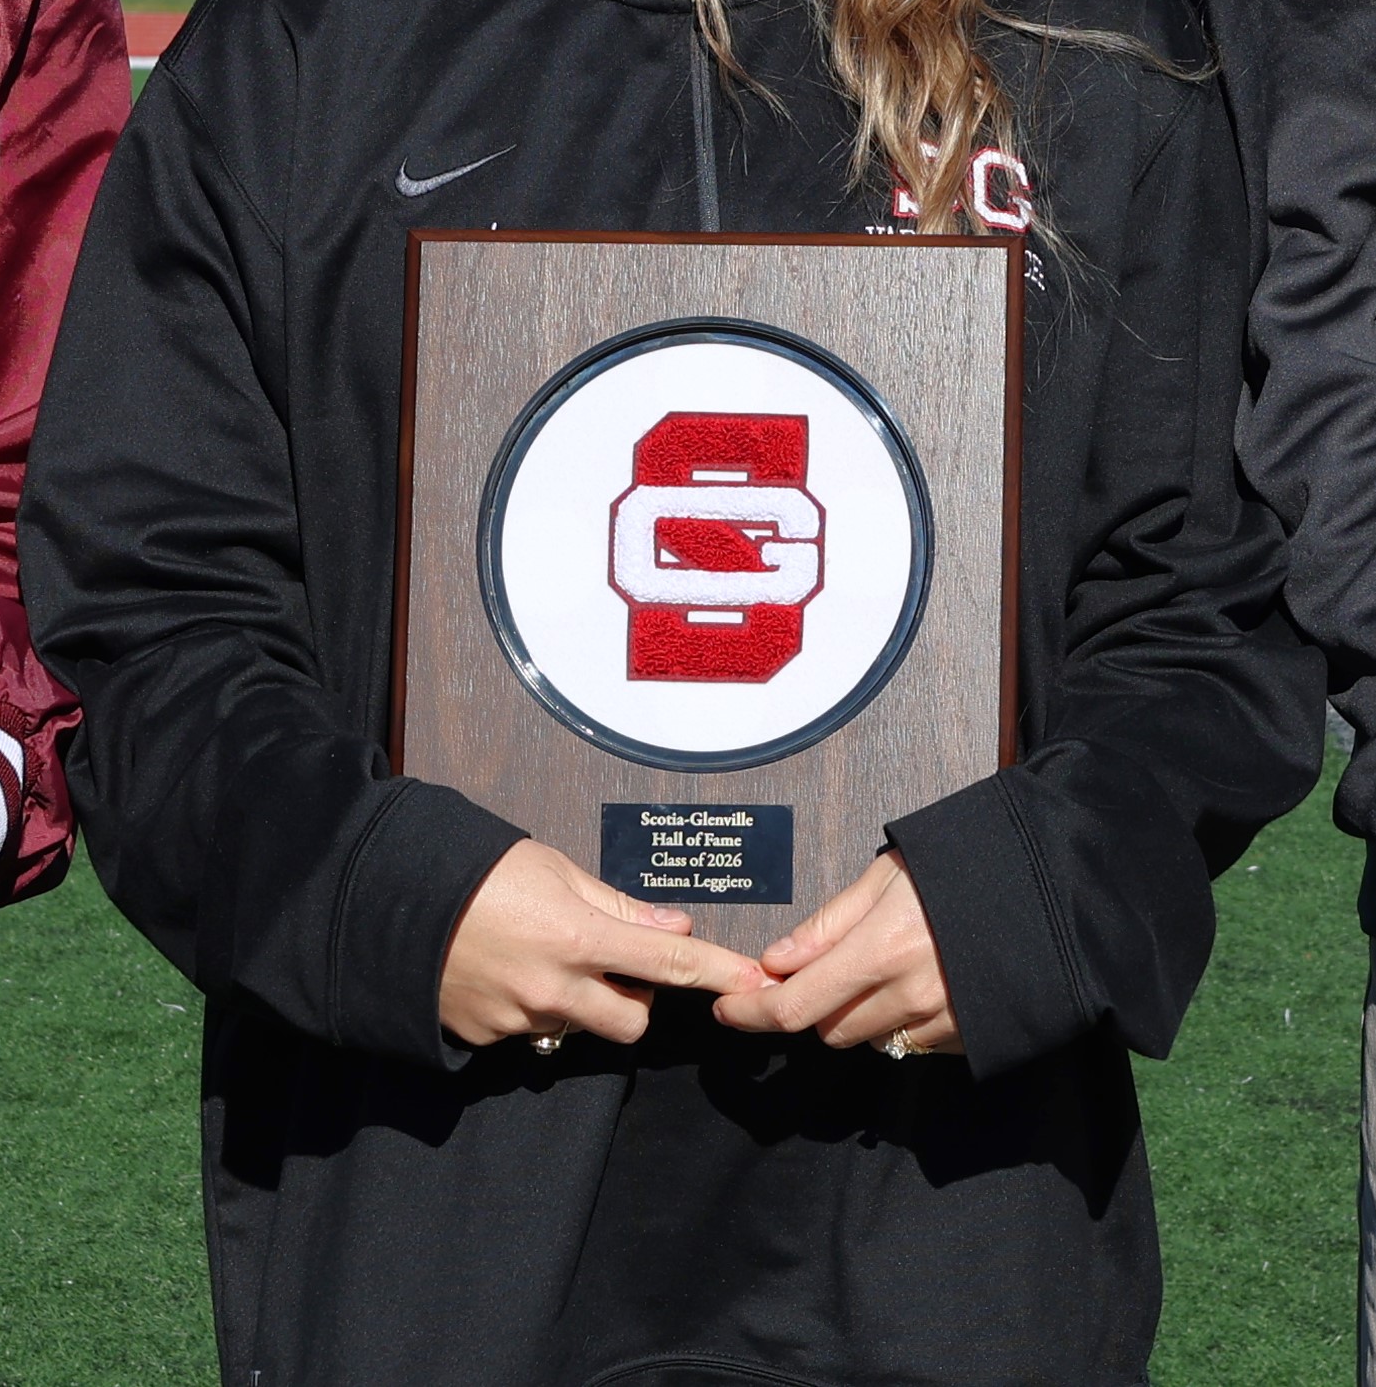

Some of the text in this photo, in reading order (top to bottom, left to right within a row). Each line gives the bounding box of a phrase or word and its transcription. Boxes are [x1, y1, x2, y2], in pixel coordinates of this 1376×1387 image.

[640, 811, 754, 827] Scotia-Glenville
[651, 831, 743, 847] Hall of Fame
[651, 851, 743, 867] Class of 2026
[640, 872, 753, 892] Tatiana Leggiero
